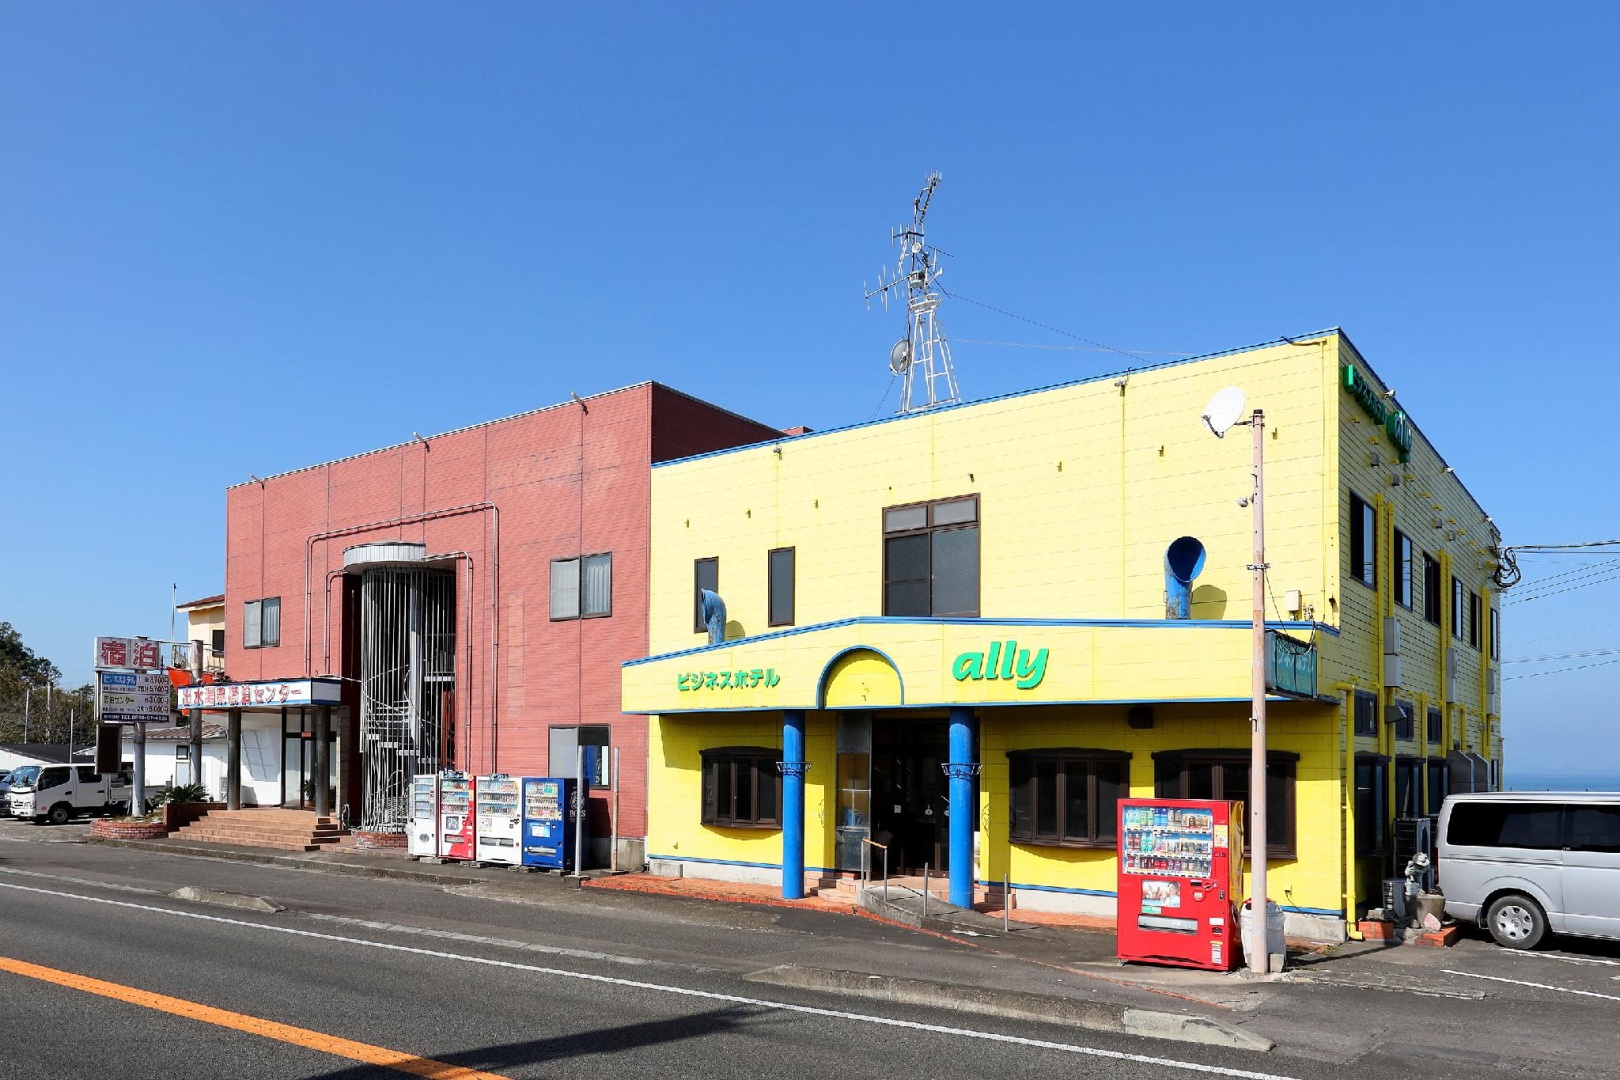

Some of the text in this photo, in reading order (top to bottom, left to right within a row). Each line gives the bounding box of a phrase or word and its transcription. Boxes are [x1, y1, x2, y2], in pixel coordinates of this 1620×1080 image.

[101, 641, 157, 667] 宿泊
[952, 641, 1049, 690] ally
[677, 668, 780, 691] ビジネスホテル
[569, 809, 586, 818] BOS
